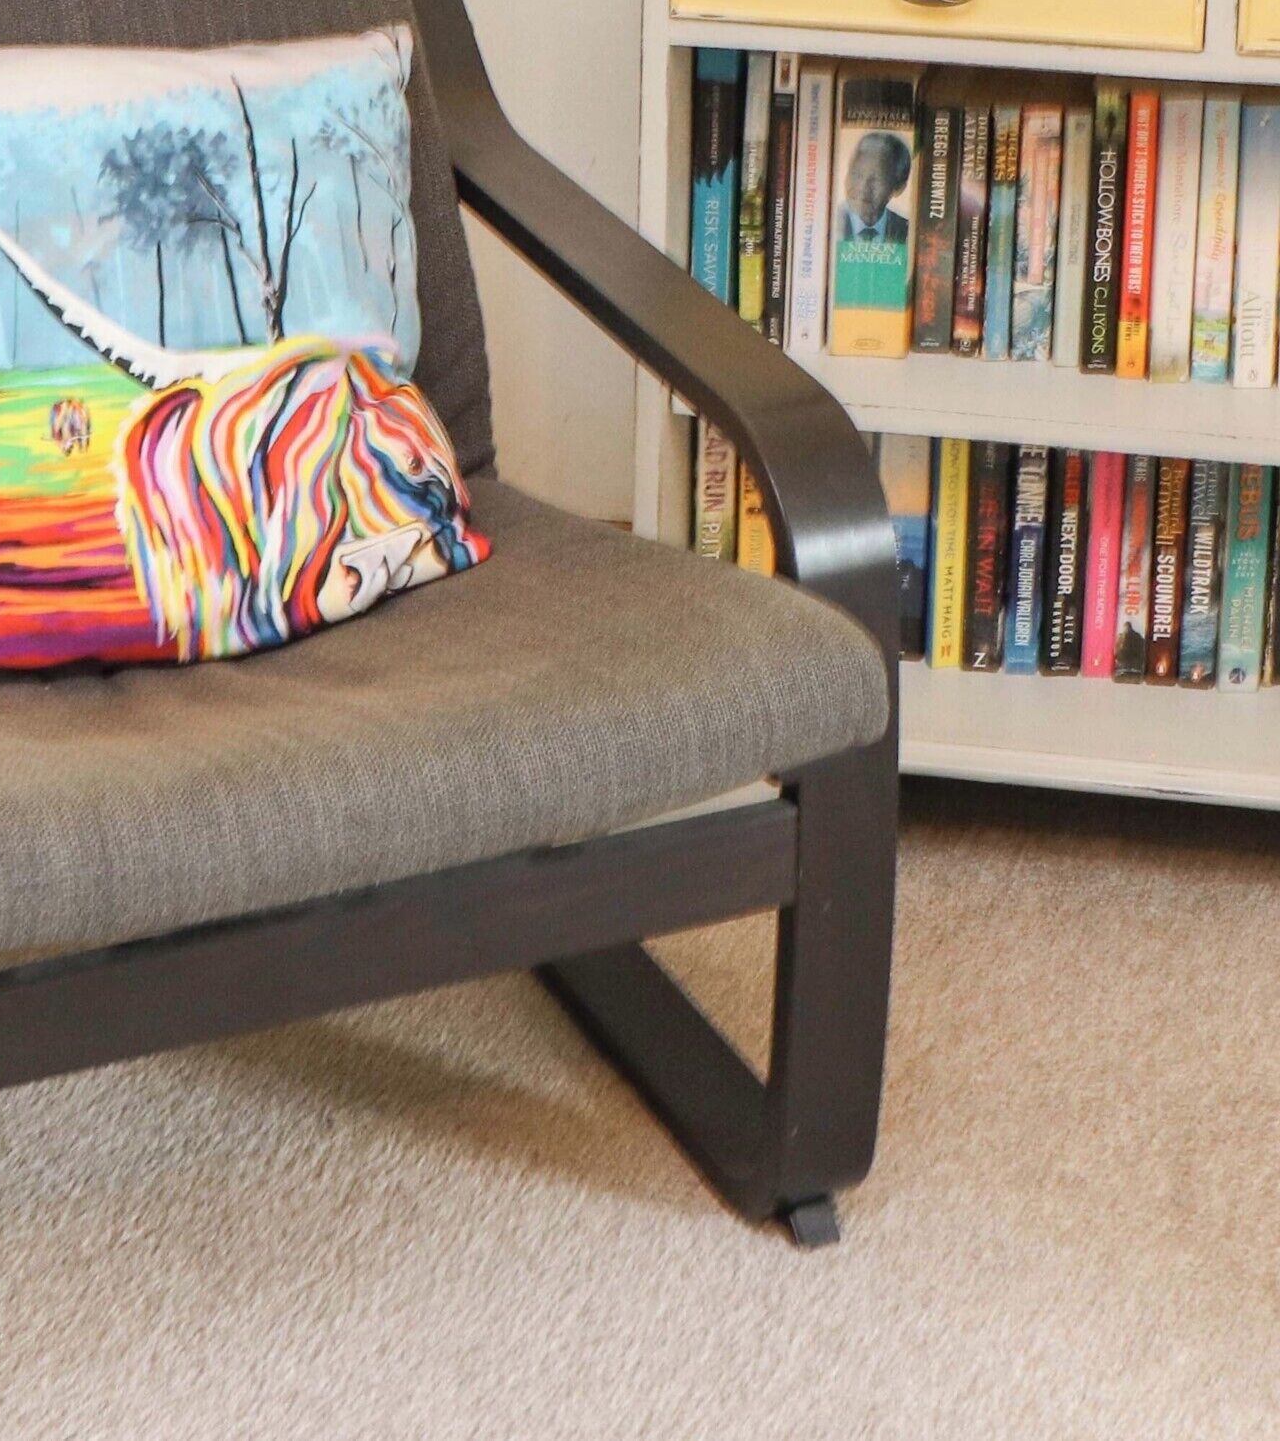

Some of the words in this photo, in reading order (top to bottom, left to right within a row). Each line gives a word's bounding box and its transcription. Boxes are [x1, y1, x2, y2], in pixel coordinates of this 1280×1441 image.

[933, 117, 949, 158] GREGG
[961, 114, 977, 182] ADAMS
[975, 115, 989, 181] DOUGLAS
[929, 162, 948, 219] HURWITZ
[1096, 148, 1117, 227] HOLLOW
[1132, 158, 1147, 196] SPIDERS
[704, 200, 719, 236] RISK
[771, 197, 784, 257] TIMEWASTER
[971, 215, 980, 230] THE
[1131, 197, 1146, 224] STICK
[847, 241, 897, 254] NELSON
[970, 232, 978, 253] LONG
[1129, 240, 1144, 264] THEIR
[1131, 228, 1144, 238] TO
[839, 253, 902, 265] MANDELA
[1093, 228, 1114, 281] BONES
[770, 258, 783, 299] LETTERS
[1091, 287, 1108, 310] C.J.
[1090, 312, 1106, 354] LYONS
[1239, 291, 1263, 359] Alliott
[704, 470, 727, 512] RUN
[1014, 464, 1047, 531] TUNNEL
[1154, 465, 1173, 545] ornwell
[1191, 461, 1210, 526] rnwell
[1205, 460, 1219, 516] ernard
[1235, 465, 1262, 541] EBUS
[977, 525, 997, 551] IN
[1061, 511, 1078, 549] NEXT
[942, 566, 954, 601] MATT
[973, 555, 994, 616] WAIT
[1017, 538, 1037, 599] CARL-JOHAN
[1056, 553, 1074, 595] DOOR
[1096, 579, 1107, 595] THE
[1097, 558, 1108, 576] FOR
[1189, 532, 1214, 614] WILDTRACK
[1095, 596, 1106, 629] MONEY
[1152, 554, 1174, 642] SCOUNDREL
[1228, 598, 1240, 639] PALIN
[1240, 586, 1255, 652] MICHAEL
[940, 605, 953, 639] HAIG
[1014, 600, 1035, 646] VALLGREN
[1048, 601, 1063, 658] MARWOOD
[1061, 614, 1075, 644] ALEX
